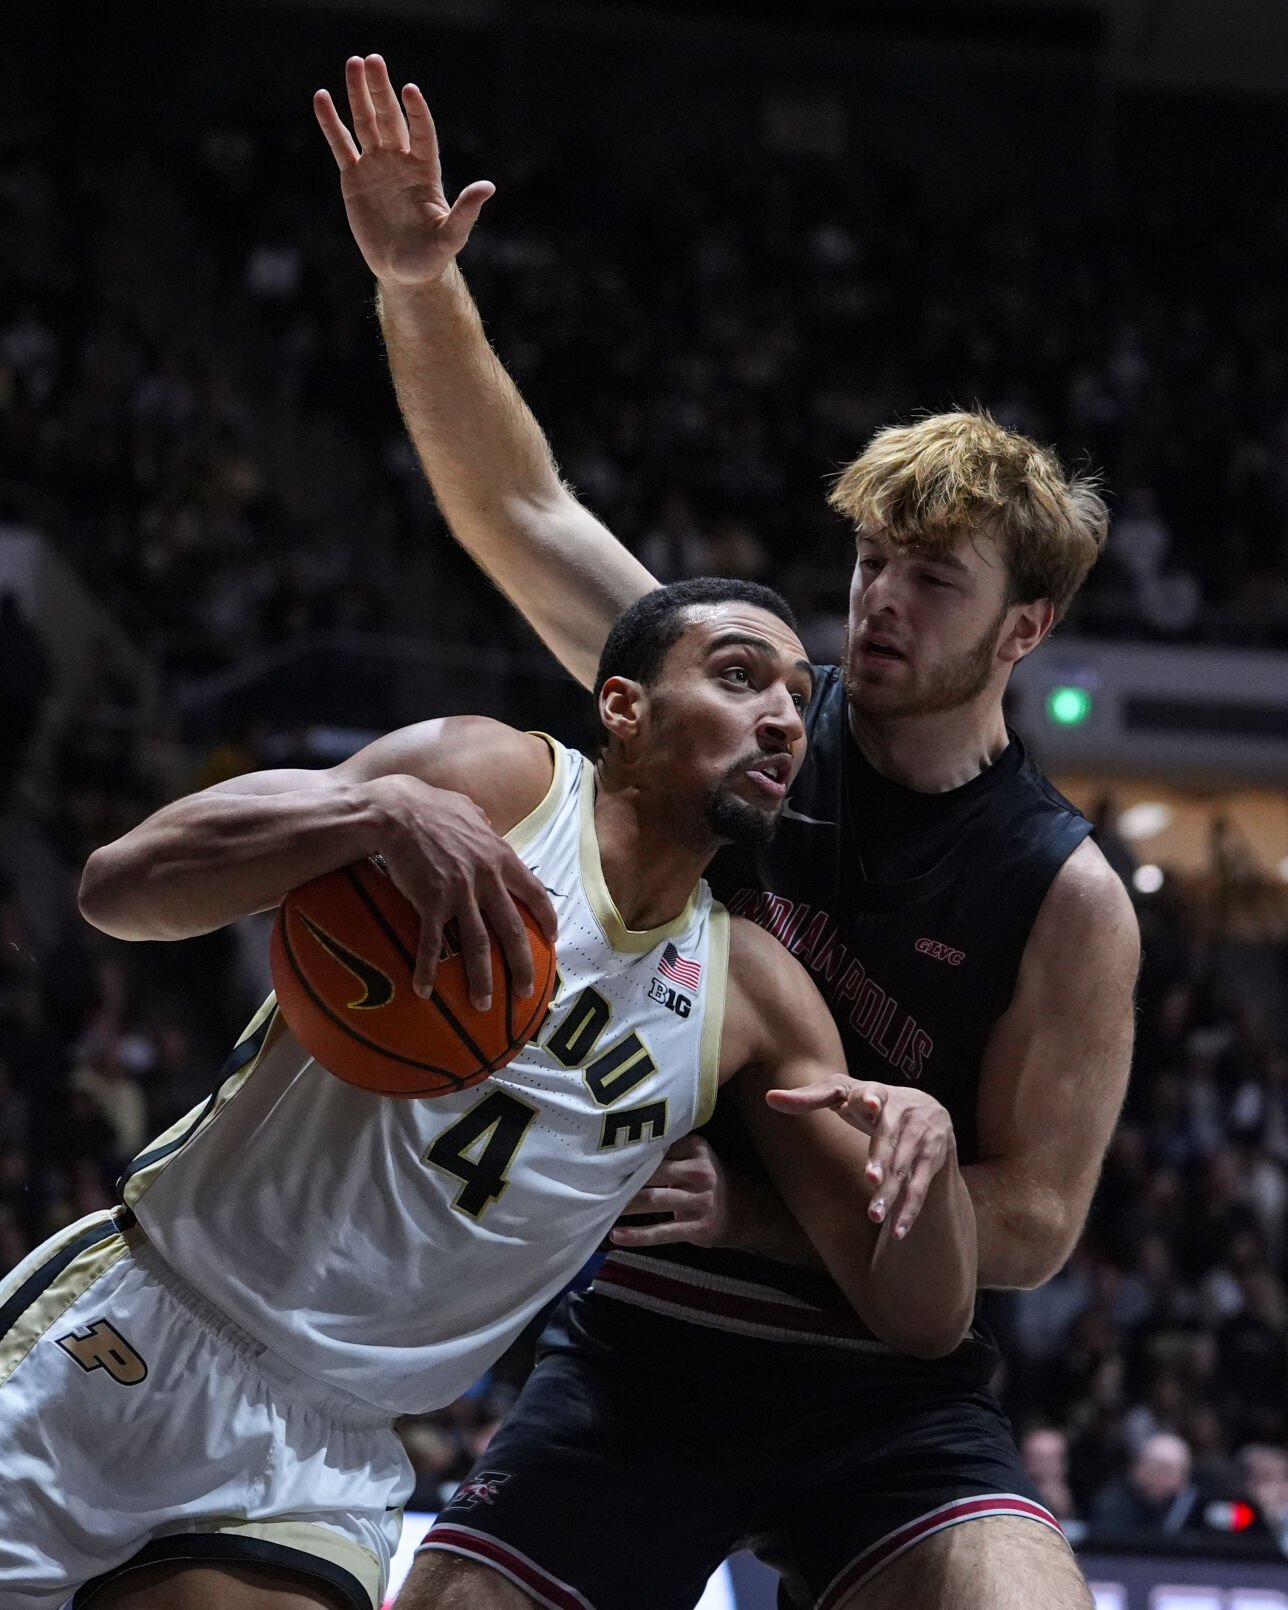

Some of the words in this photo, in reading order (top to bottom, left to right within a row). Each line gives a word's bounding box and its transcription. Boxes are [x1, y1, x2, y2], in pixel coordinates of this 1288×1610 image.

[914, 937, 966, 966] GLVC
[421, 1084, 541, 1222] 4
[54, 1318, 148, 1386] P
